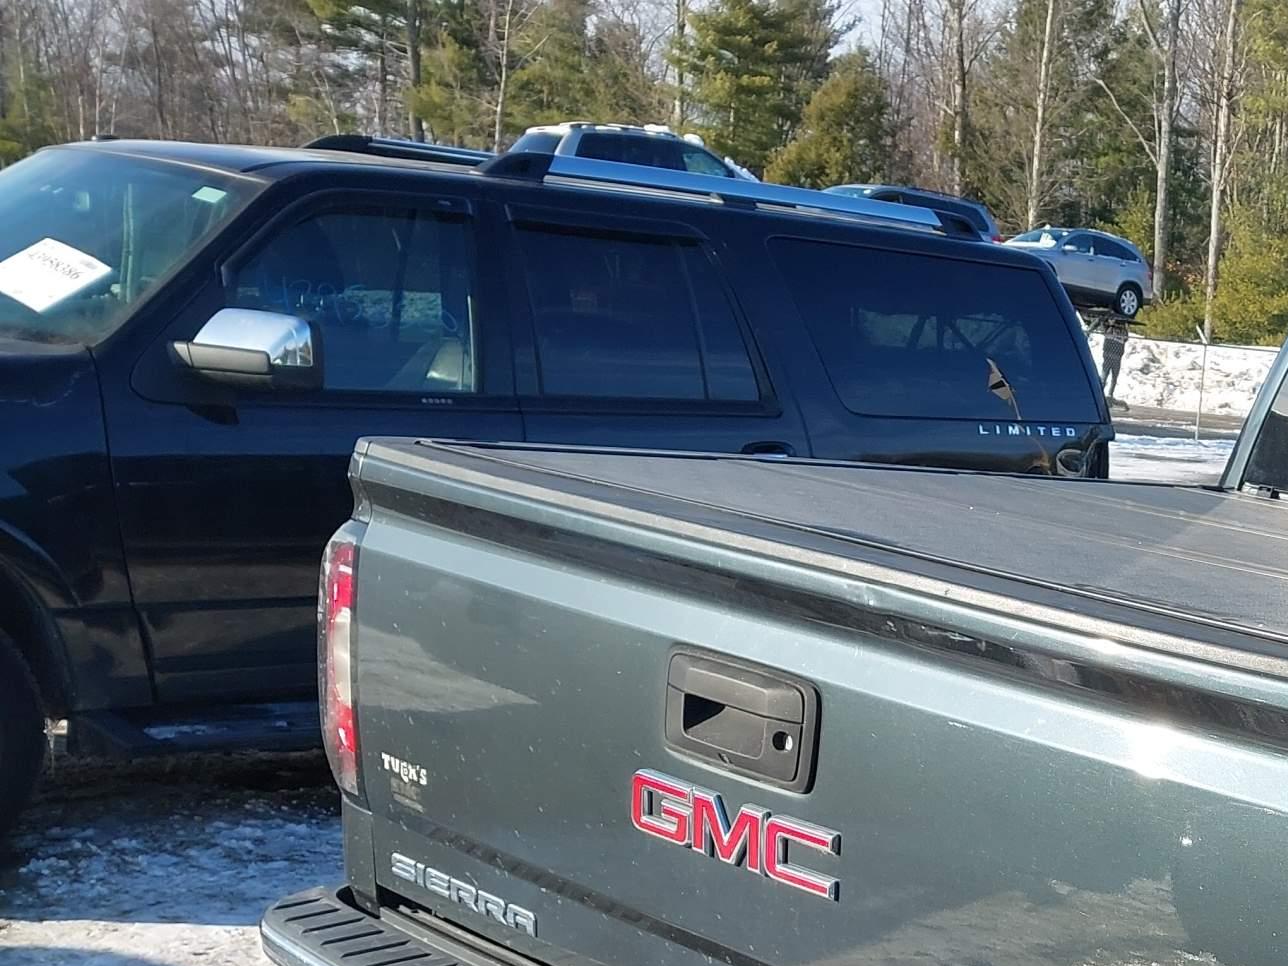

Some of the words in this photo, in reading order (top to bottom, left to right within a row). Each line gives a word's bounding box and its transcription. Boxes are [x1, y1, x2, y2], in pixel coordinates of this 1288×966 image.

[978, 423, 1077, 437] LIMITED
[630, 767, 842, 903] GMC
[390, 850, 539, 938] SIERRA
